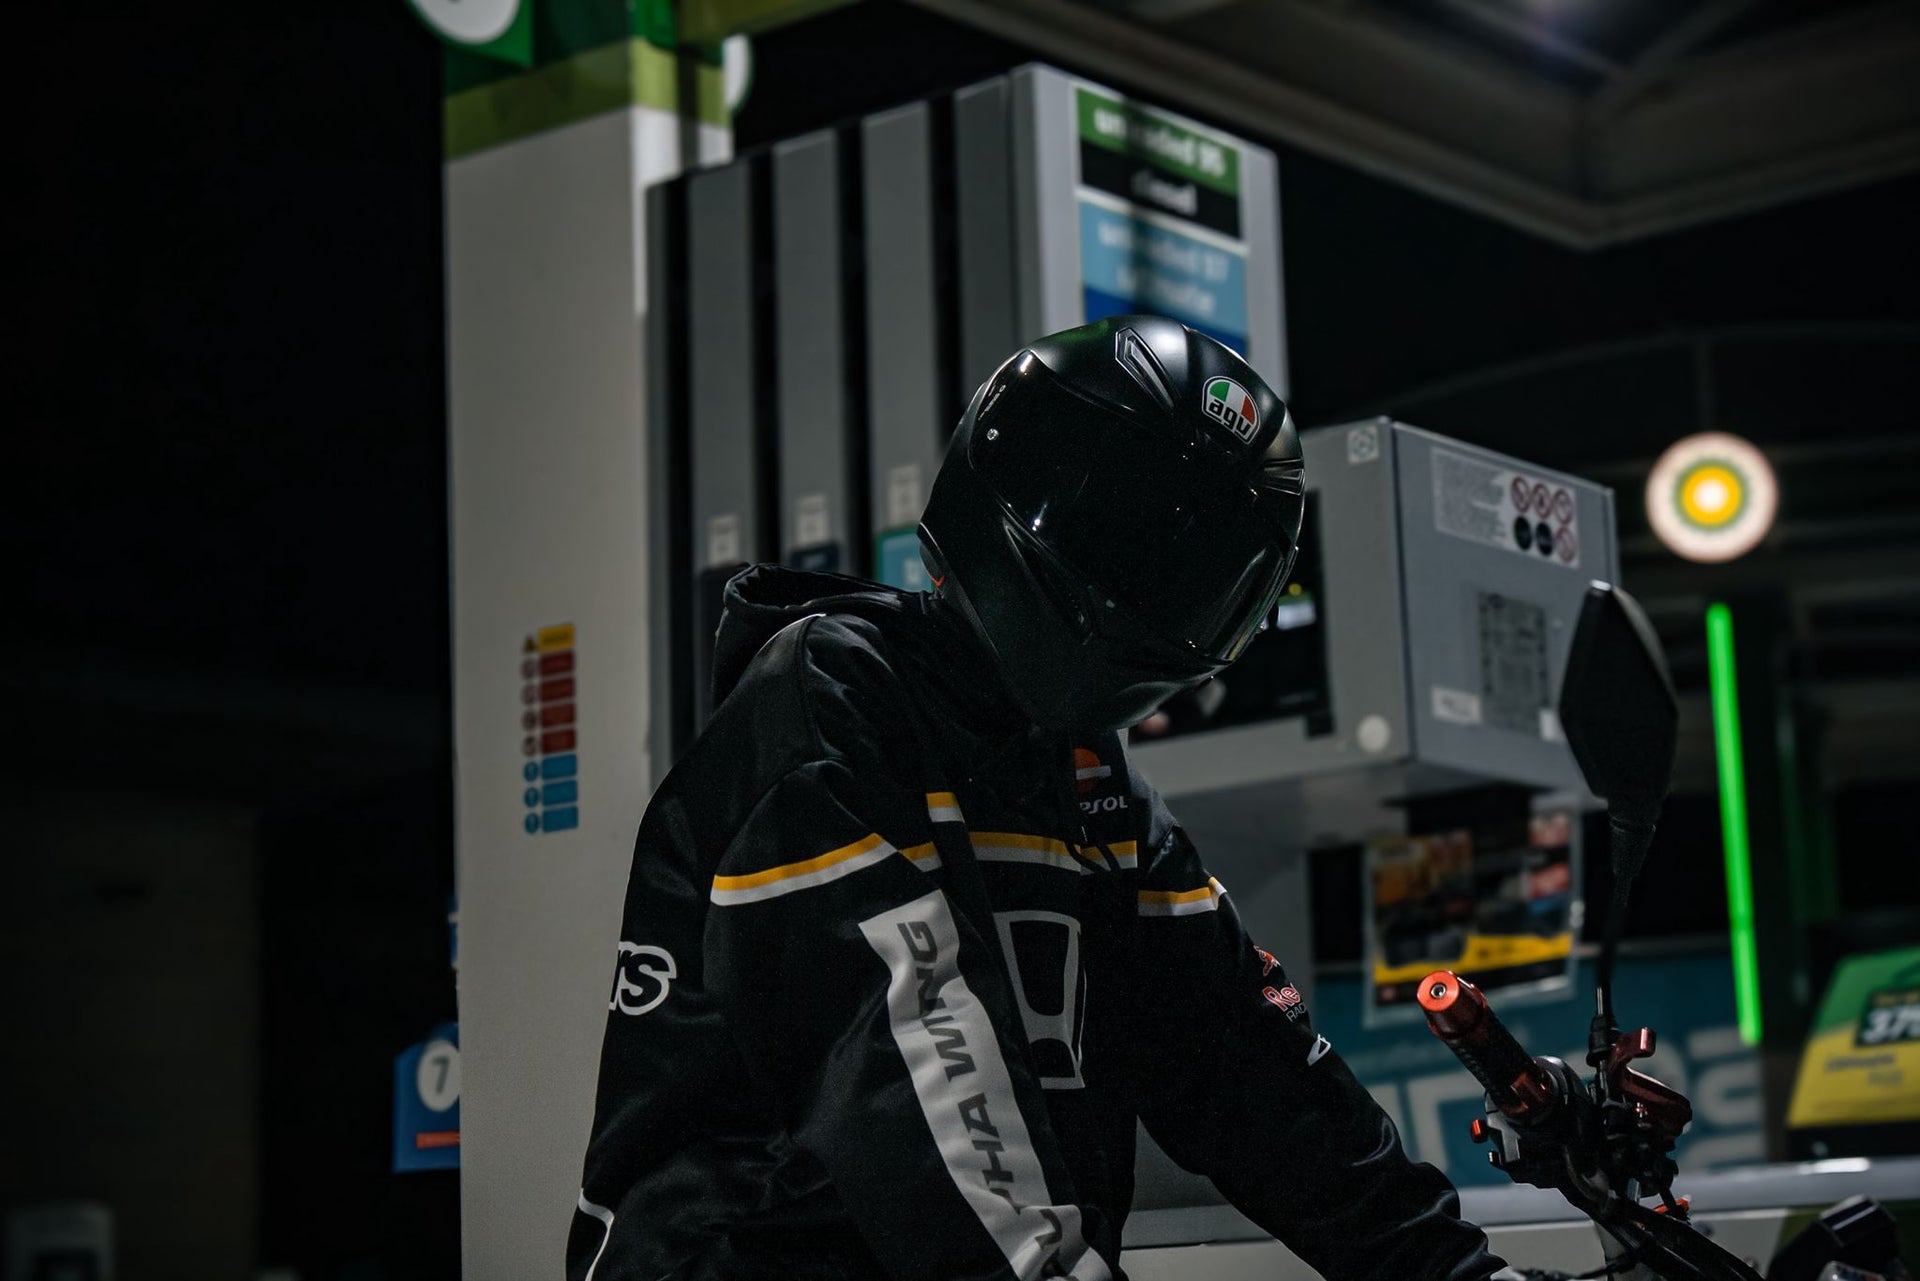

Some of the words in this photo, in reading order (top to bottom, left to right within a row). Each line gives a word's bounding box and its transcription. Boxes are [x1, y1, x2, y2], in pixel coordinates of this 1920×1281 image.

[1208, 399, 1252, 436] agv
[897, 920, 977, 1083] WING
[1261, 982, 1301, 1012] Re
[432, 1055, 450, 1095] 7
